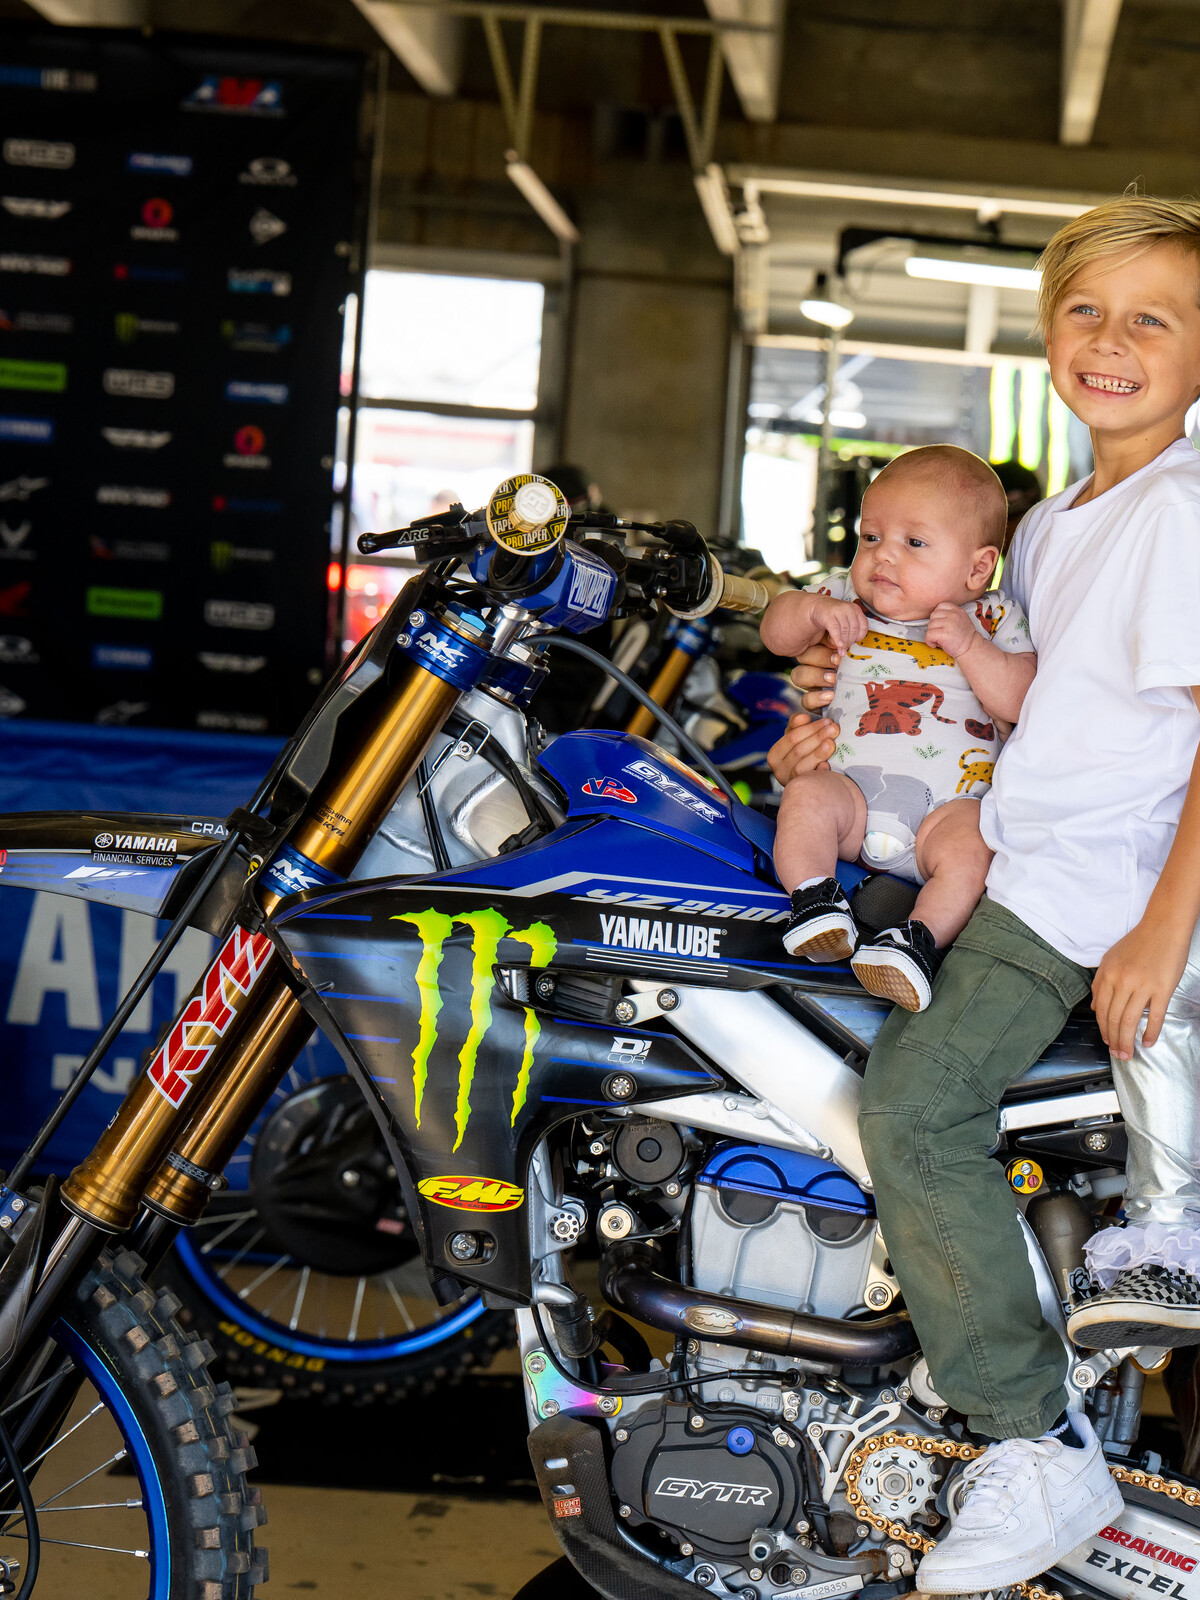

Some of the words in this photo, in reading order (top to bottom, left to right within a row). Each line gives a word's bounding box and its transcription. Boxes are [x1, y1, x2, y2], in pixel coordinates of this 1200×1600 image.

[398, 528, 430, 544] ARC
[505, 528, 548, 548] PROTAPER
[416, 640, 458, 669] NEKEN
[624, 760, 723, 822] GYTR
[317, 803, 353, 826] ASHIMA
[191, 822, 229, 836] CRAI
[114, 834, 178, 852] YAMAHA
[93, 852, 134, 864] FINANCIAL
[135, 854, 174, 867] SERVICES
[418, 1179, 525, 1206] FMF
[654, 1477, 773, 1505] GYTR
[554, 1498, 581, 1508] LIGHT
[1099, 1526, 1199, 1573] BRAKING
[1085, 1548, 1189, 1600] EXCEL
